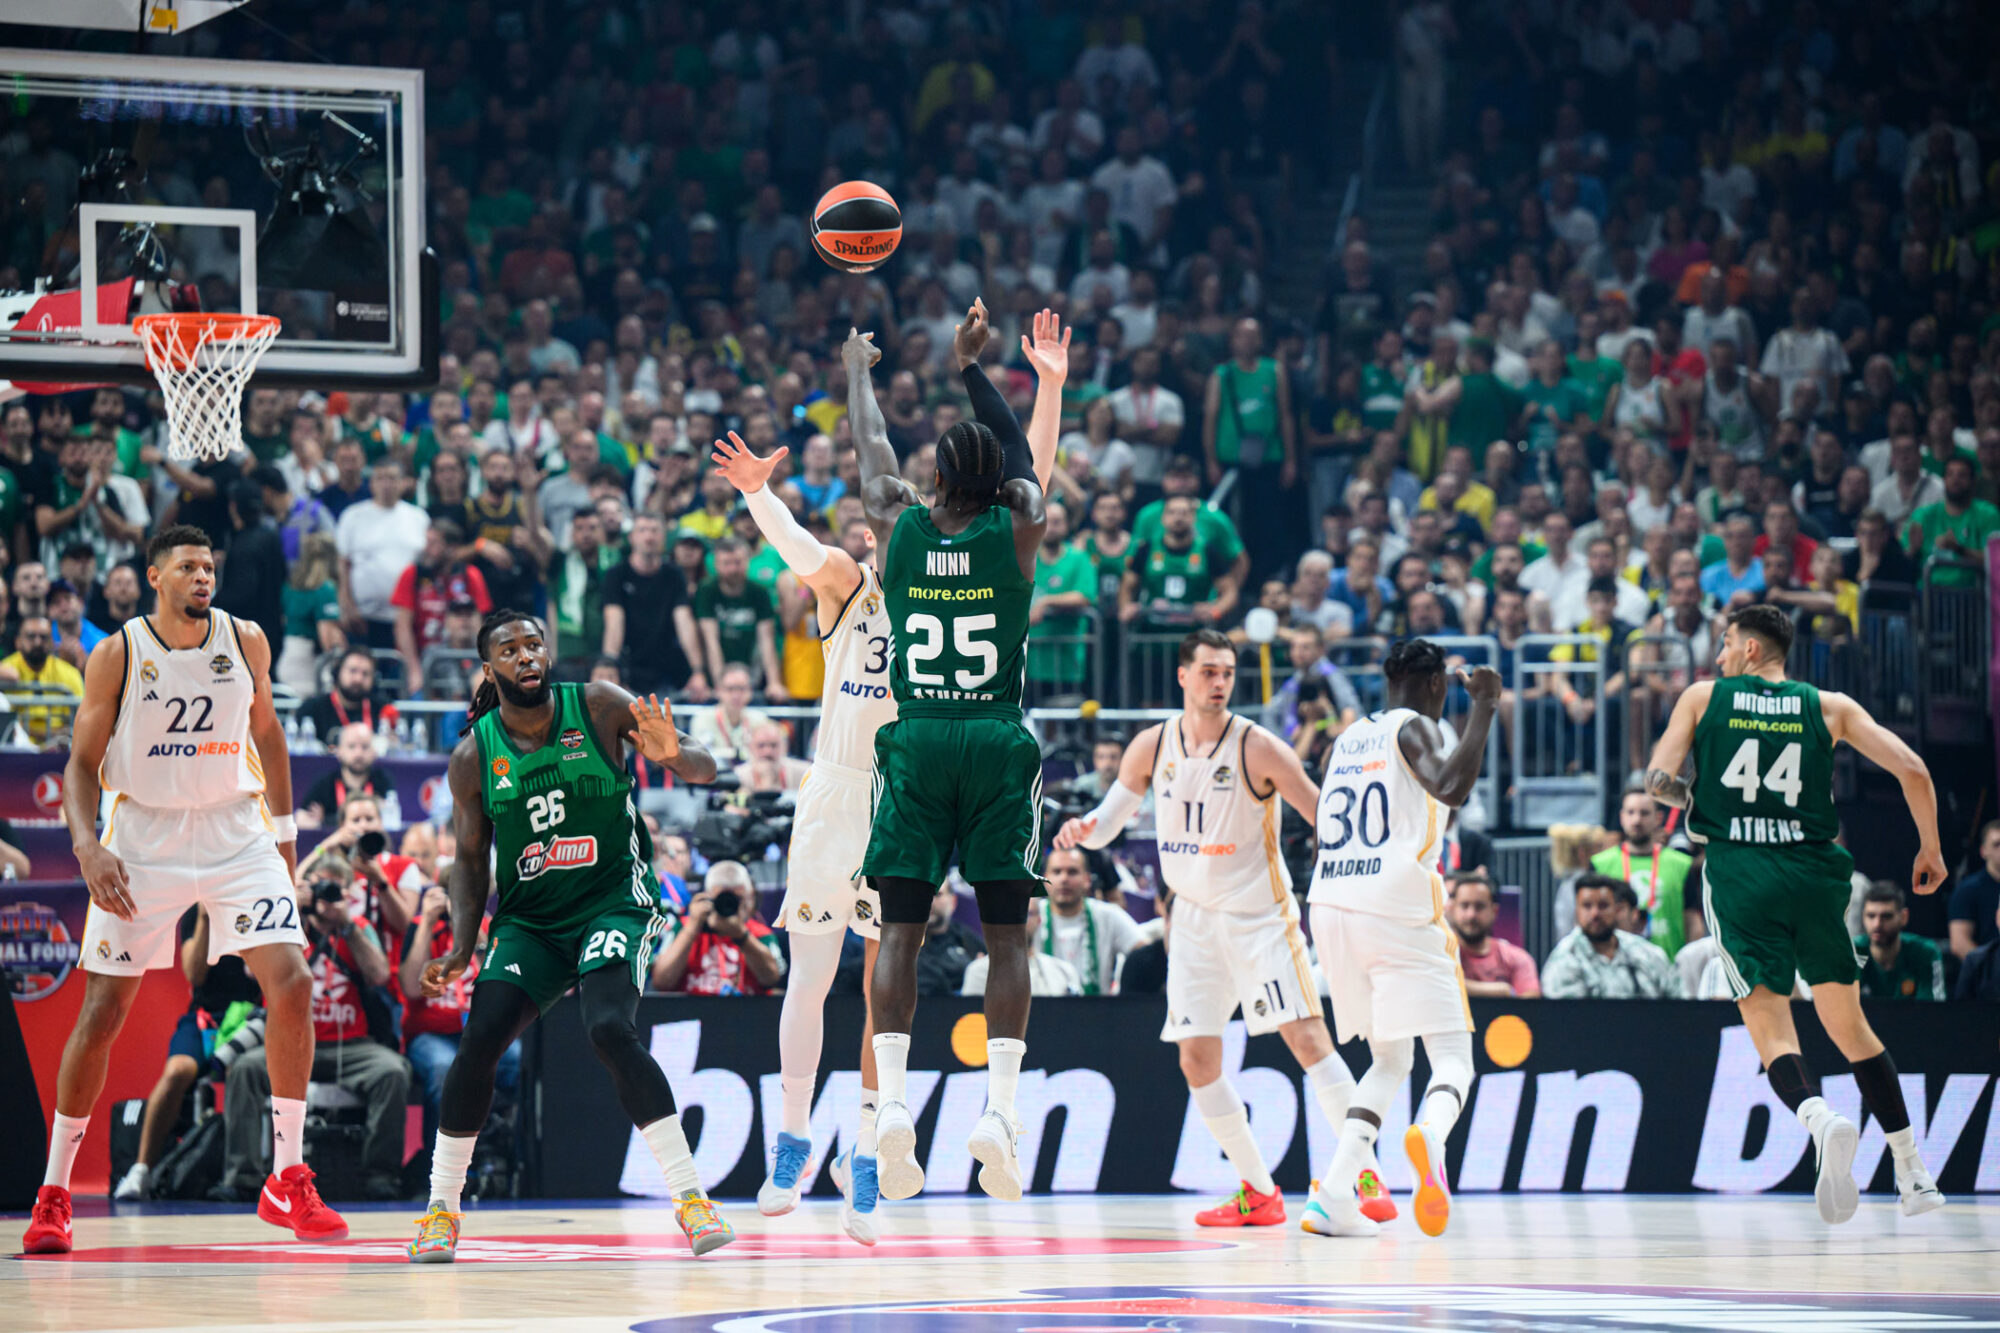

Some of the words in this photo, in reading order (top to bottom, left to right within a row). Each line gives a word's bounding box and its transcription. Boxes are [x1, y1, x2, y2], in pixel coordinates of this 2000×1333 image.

[833, 238, 894, 255] SPALDING
[926, 550, 970, 576] NUNN
[908, 586, 994, 600] more.com
[905, 613, 998, 690] 25
[840, 680, 891, 699] AUTO
[1733, 691, 1802, 715] MITOGLOU
[165, 695, 214, 733] 22
[1728, 717, 1804, 734] more.com
[147, 741, 240, 757] AUTOHERO
[1720, 738, 1803, 808] 44
[526, 789, 566, 833] 26
[1182, 801, 1204, 834] 11
[1319, 781, 1390, 850] 30
[1729, 816, 1805, 843] ATHENS
[1321, 857, 1382, 880] MADRID
[252, 896, 297, 932] 22
[584, 929, 627, 962] 26
[1263, 979, 1285, 1012] 11
